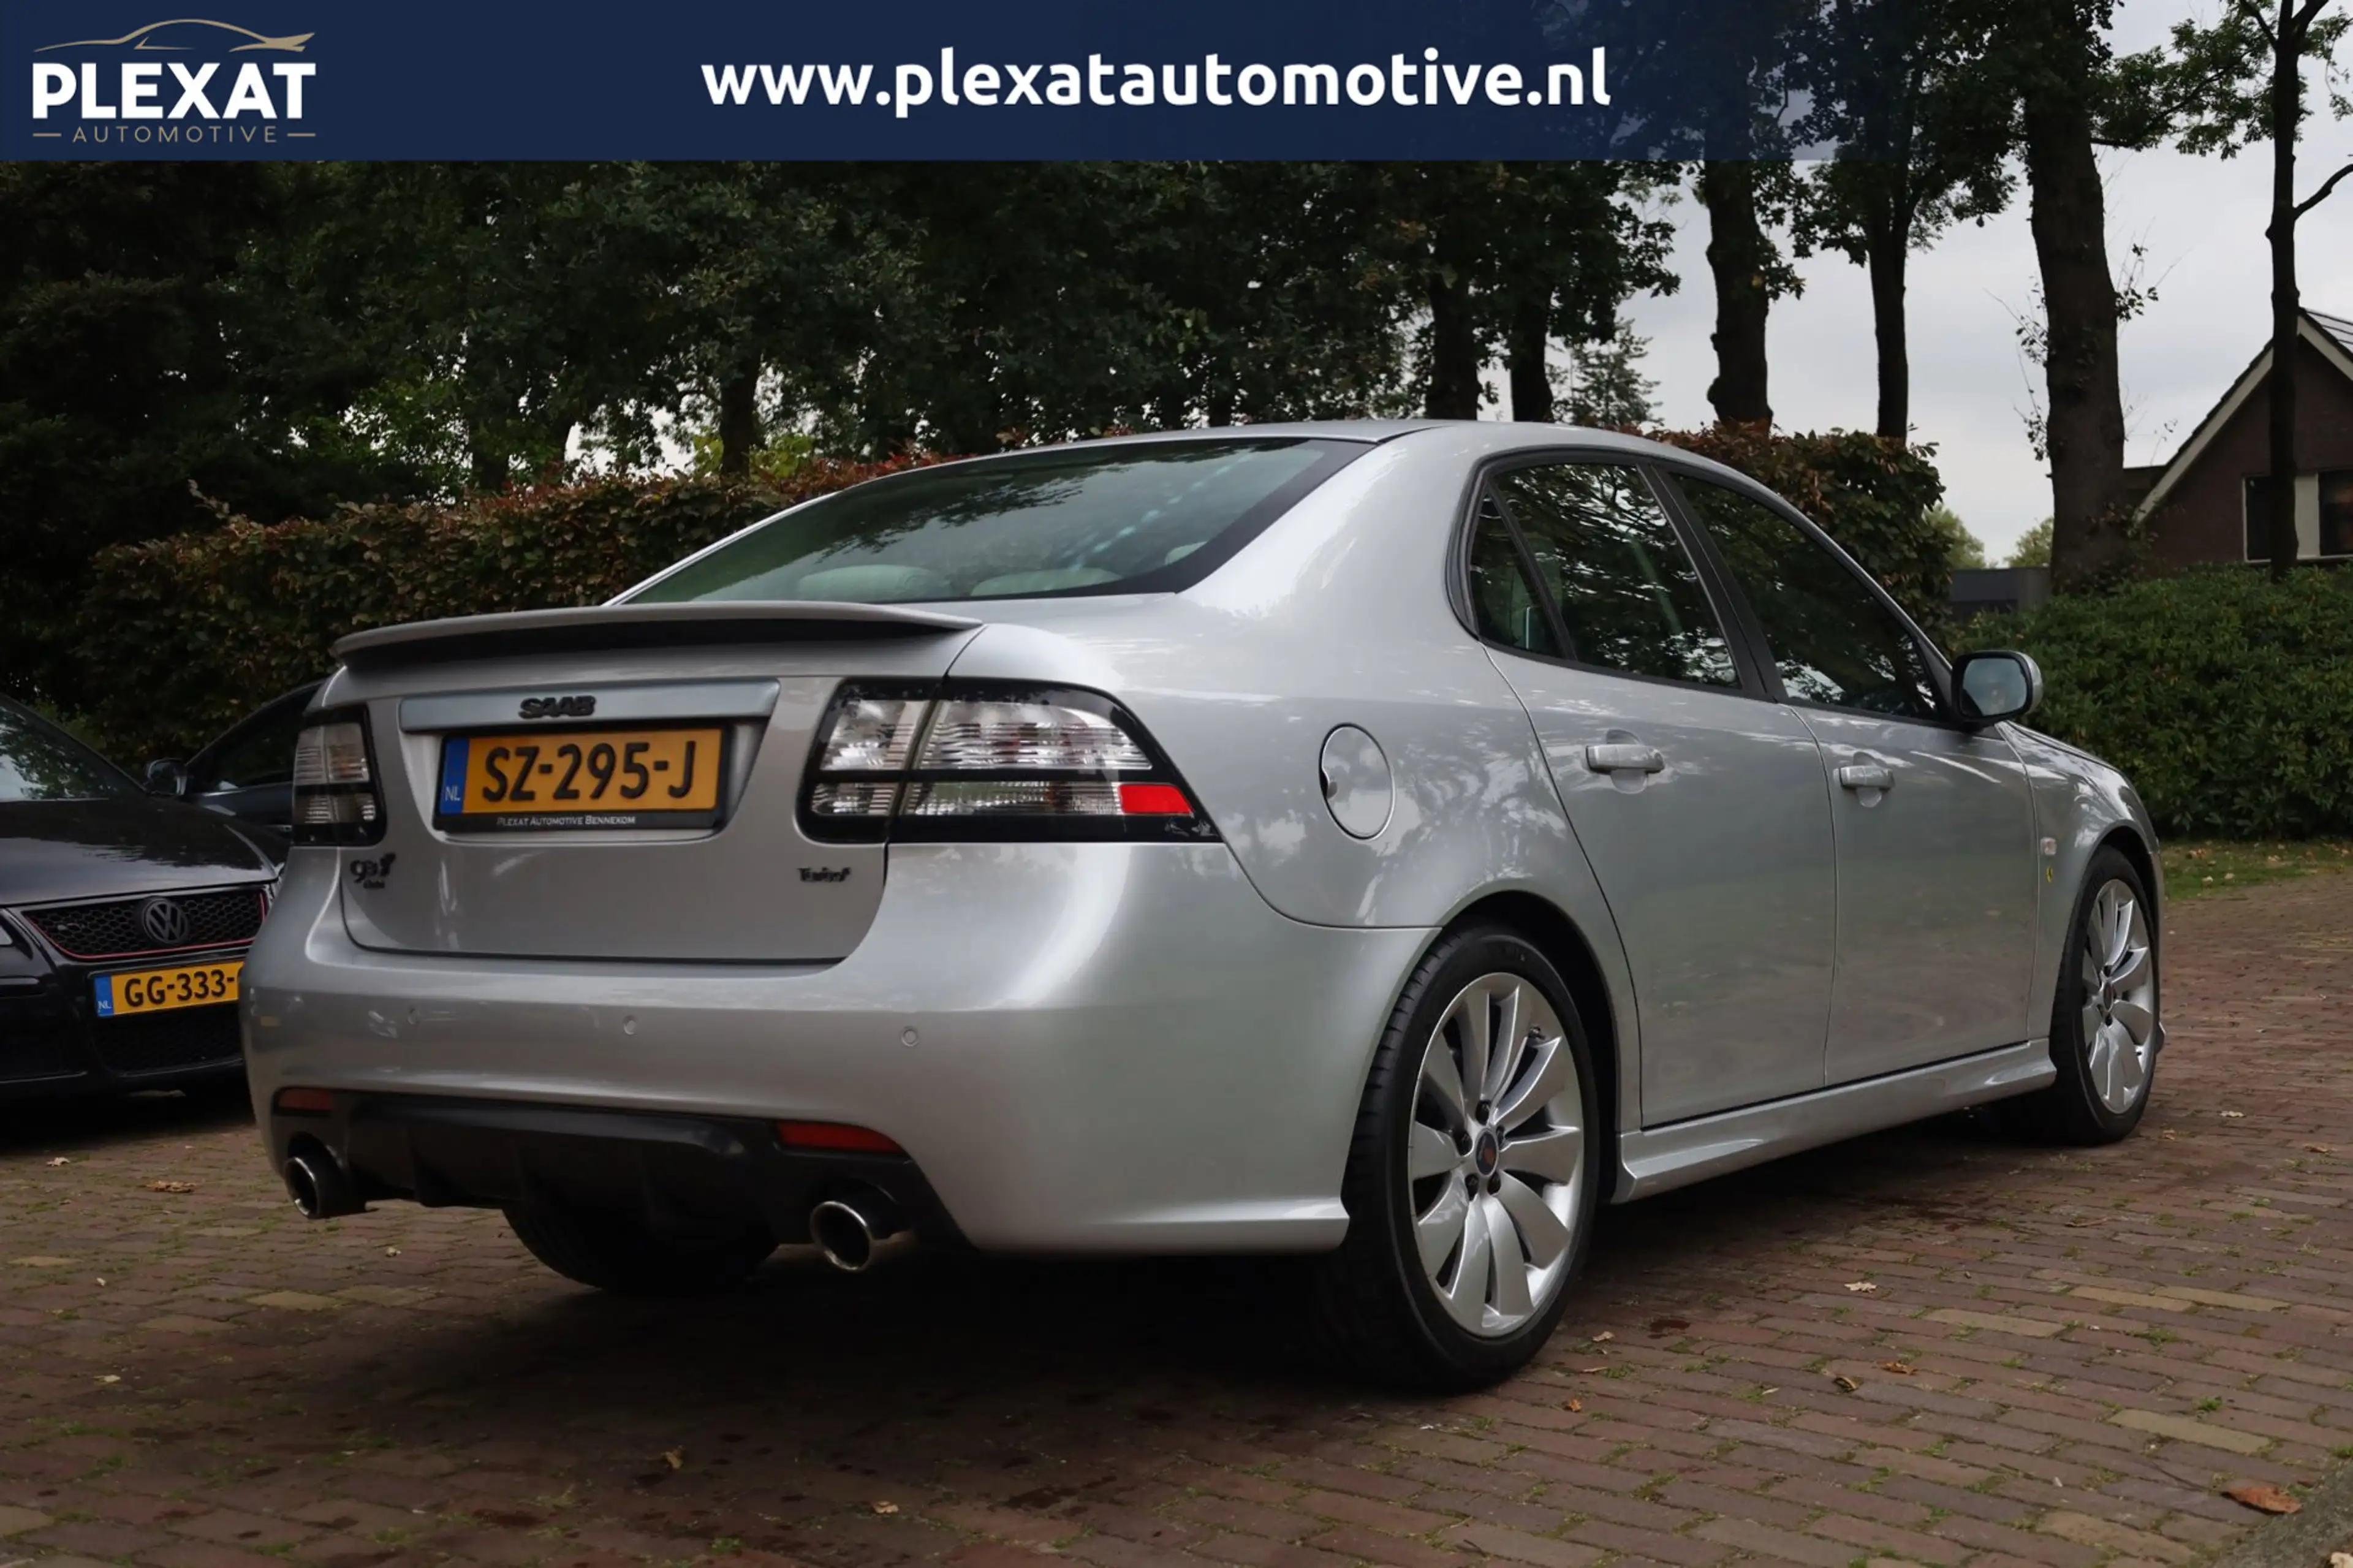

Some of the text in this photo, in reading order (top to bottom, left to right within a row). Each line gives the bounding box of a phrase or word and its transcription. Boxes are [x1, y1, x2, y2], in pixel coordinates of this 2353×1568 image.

[518, 695, 596, 719] SAAB
[482, 740, 696, 802] SZ-295-J
[445, 787, 461, 801] NL
[124, 968, 243, 1007] GG-333-
[97, 1000, 112, 1010] NL
